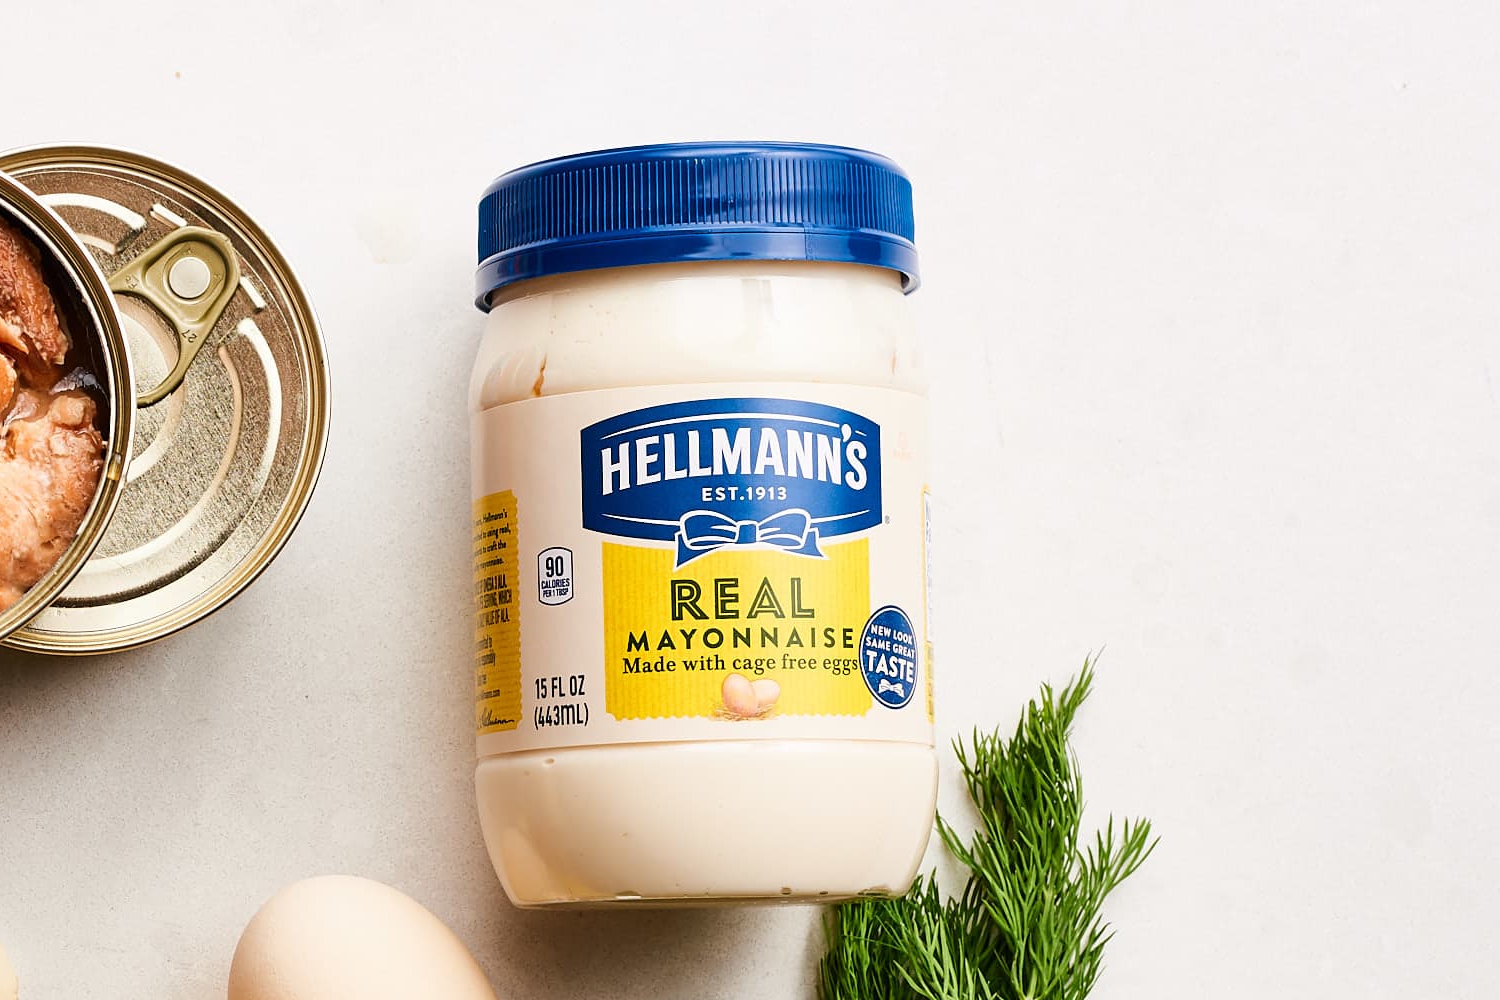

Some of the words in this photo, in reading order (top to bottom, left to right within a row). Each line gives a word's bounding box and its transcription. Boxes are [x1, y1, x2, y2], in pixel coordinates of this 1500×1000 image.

[600, 423, 868, 496] HELLMANN'S
[545, 556, 564, 577] 90
[541, 578, 570, 590] CALORIES
[543, 589, 552, 598] PER
[556, 588, 569, 597] TBSP
[670, 576, 815, 622] REAL
[626, 627, 854, 652] MAYONNAISE
[870, 624, 891, 638] NEW
[892, 630, 913, 645] LOOK
[865, 636, 891, 651] SAME
[892, 642, 916, 659] GREAT
[622, 655, 678, 674] Made
[682, 653, 727, 672] with
[731, 657, 776, 675] cage
[781, 653, 818, 671] free
[822, 658, 859, 677] eggs
[866, 650, 914, 684] TASTE
[535, 678, 548, 699] 15
[551, 676, 565, 698] FL
[569, 675, 585, 696] OZ
